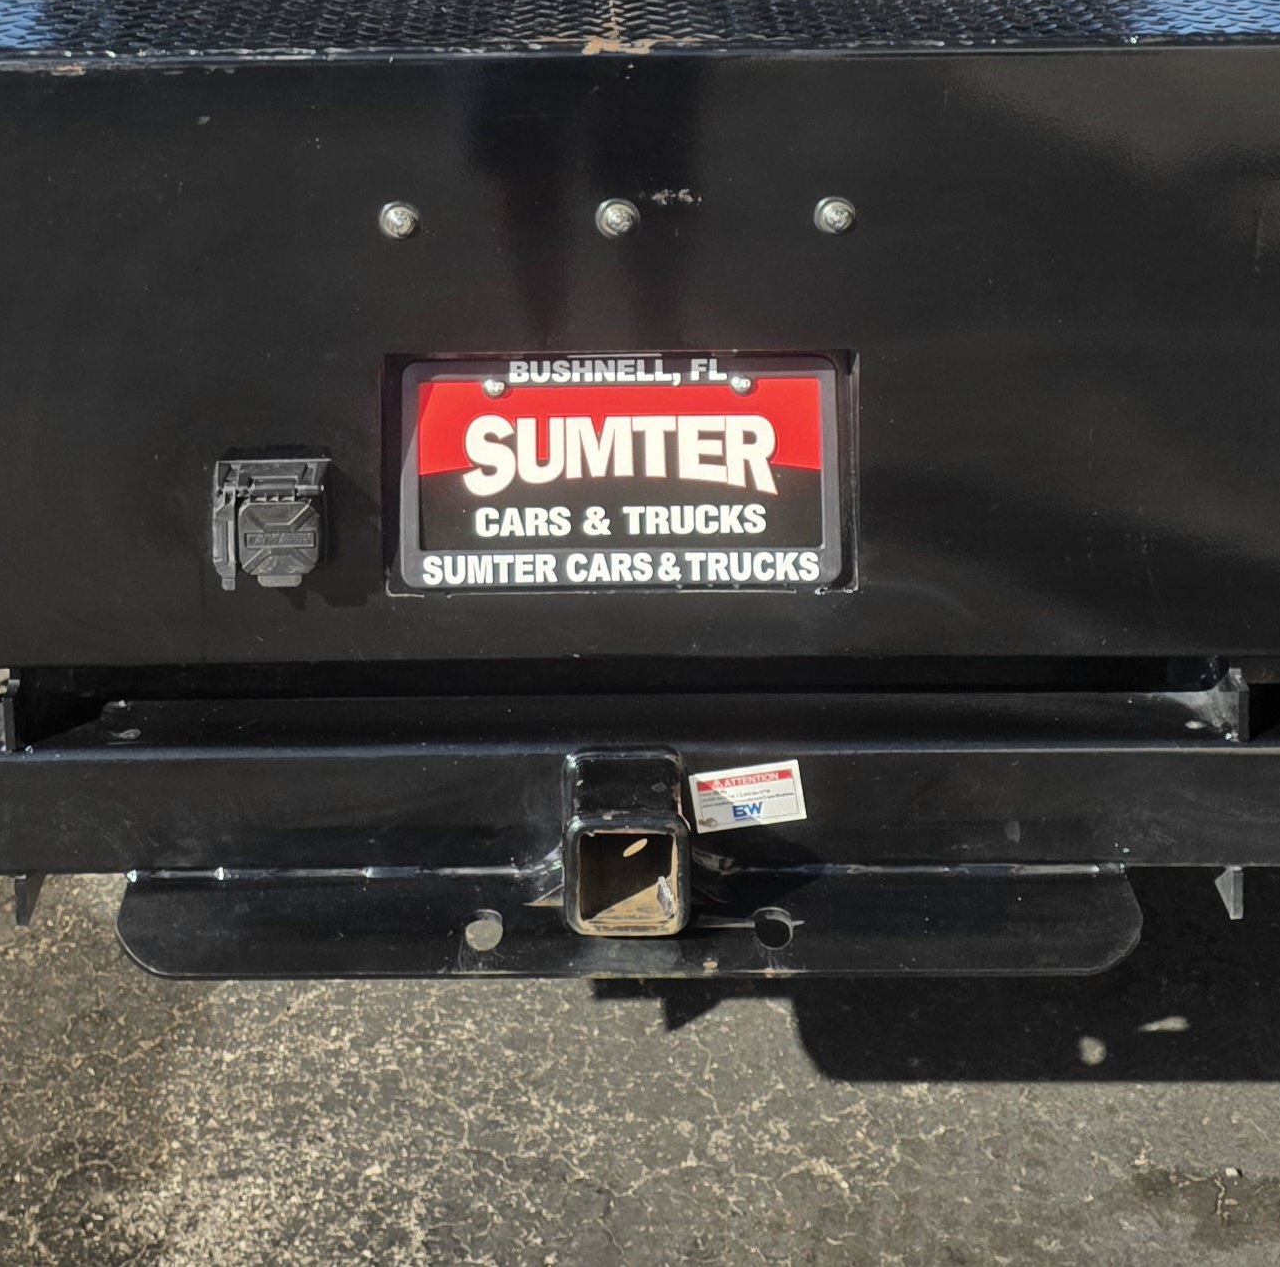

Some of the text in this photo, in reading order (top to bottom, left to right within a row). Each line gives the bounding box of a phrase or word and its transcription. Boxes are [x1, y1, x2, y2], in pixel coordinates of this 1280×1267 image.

[508, 357, 728, 386] BUSHNELL, FL
[462, 414, 779, 496] SUMTER
[475, 504, 767, 537] CARS & TRUCKS
[422, 551, 820, 586] SUMTER CARS & TRUCKS
[724, 772, 779, 788] ATTENTION
